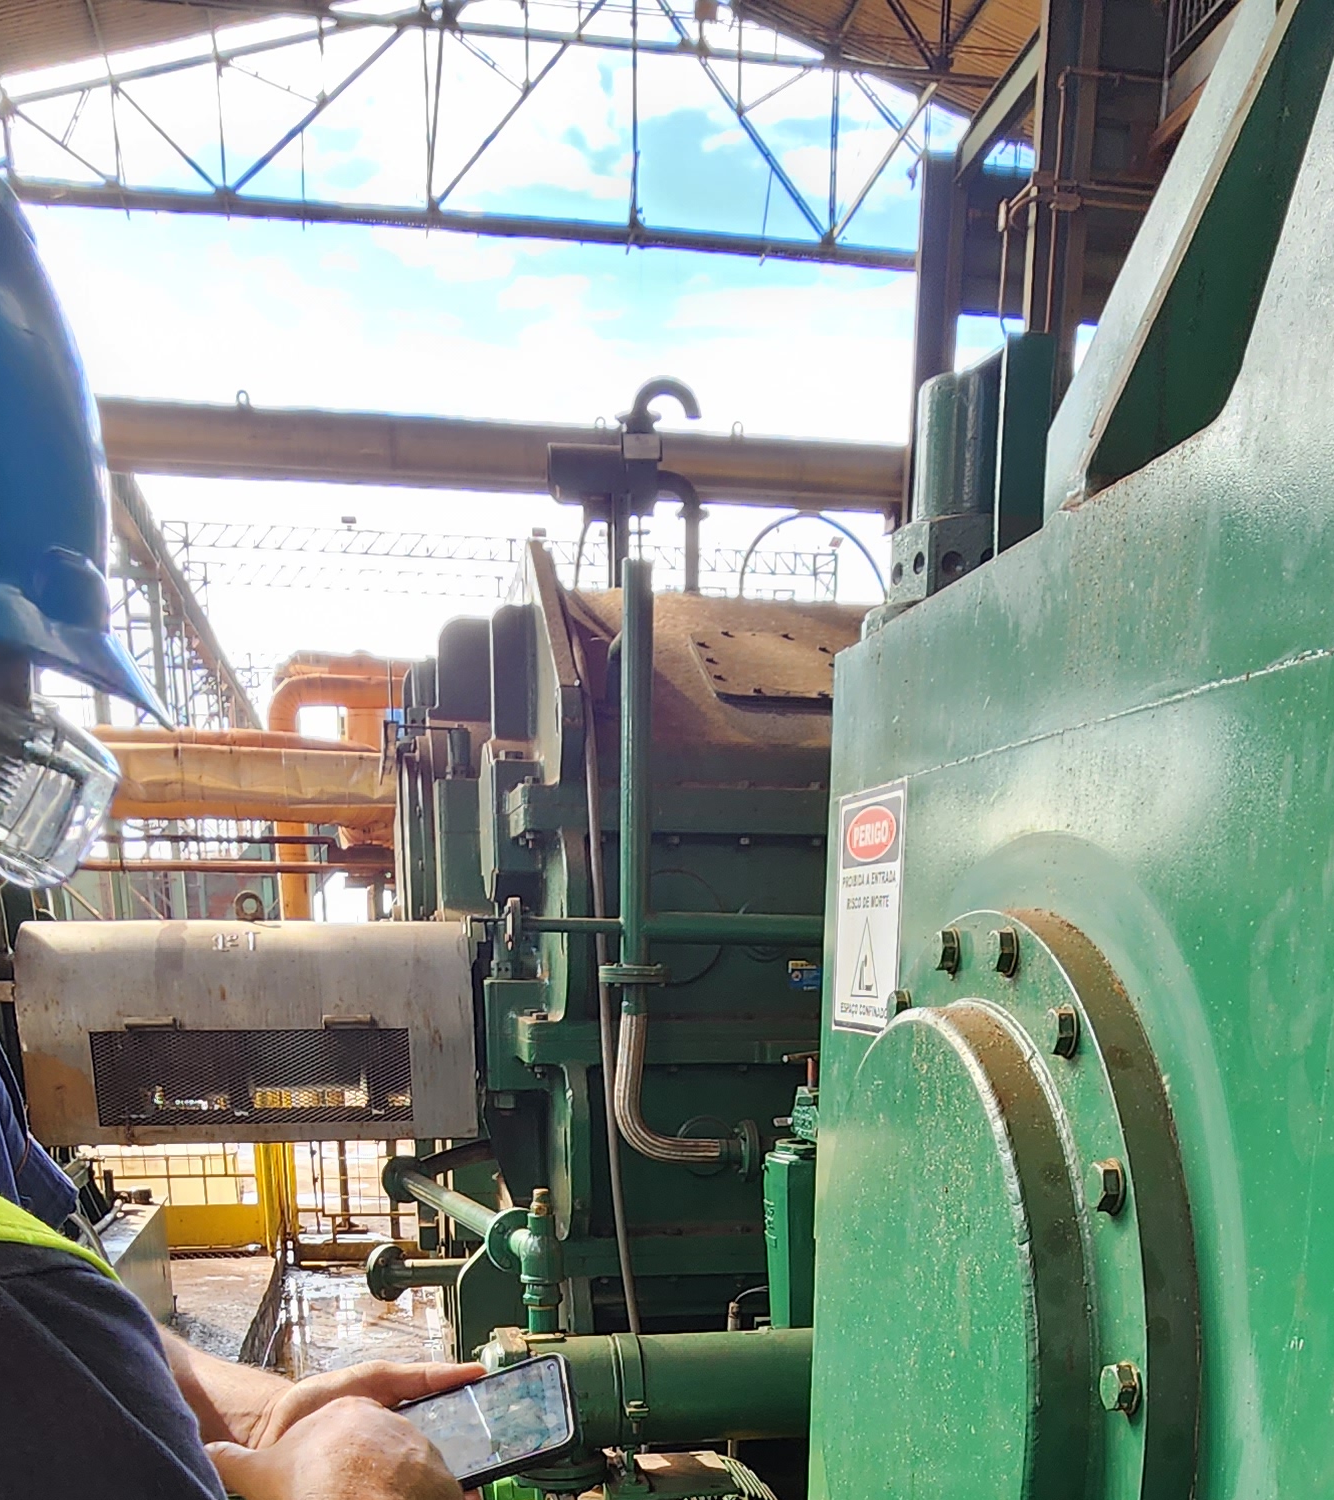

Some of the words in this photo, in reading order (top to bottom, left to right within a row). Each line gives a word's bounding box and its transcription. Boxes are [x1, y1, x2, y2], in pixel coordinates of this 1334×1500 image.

[852, 818, 889, 849] PERIGO
[842, 873, 865, 888] PROIBIDA
[846, 896, 862, 910] RISCO
[862, 895, 870, 909] DE
[870, 893, 890, 908] MORTE
[840, 1001, 858, 1018] ESPAÇO
